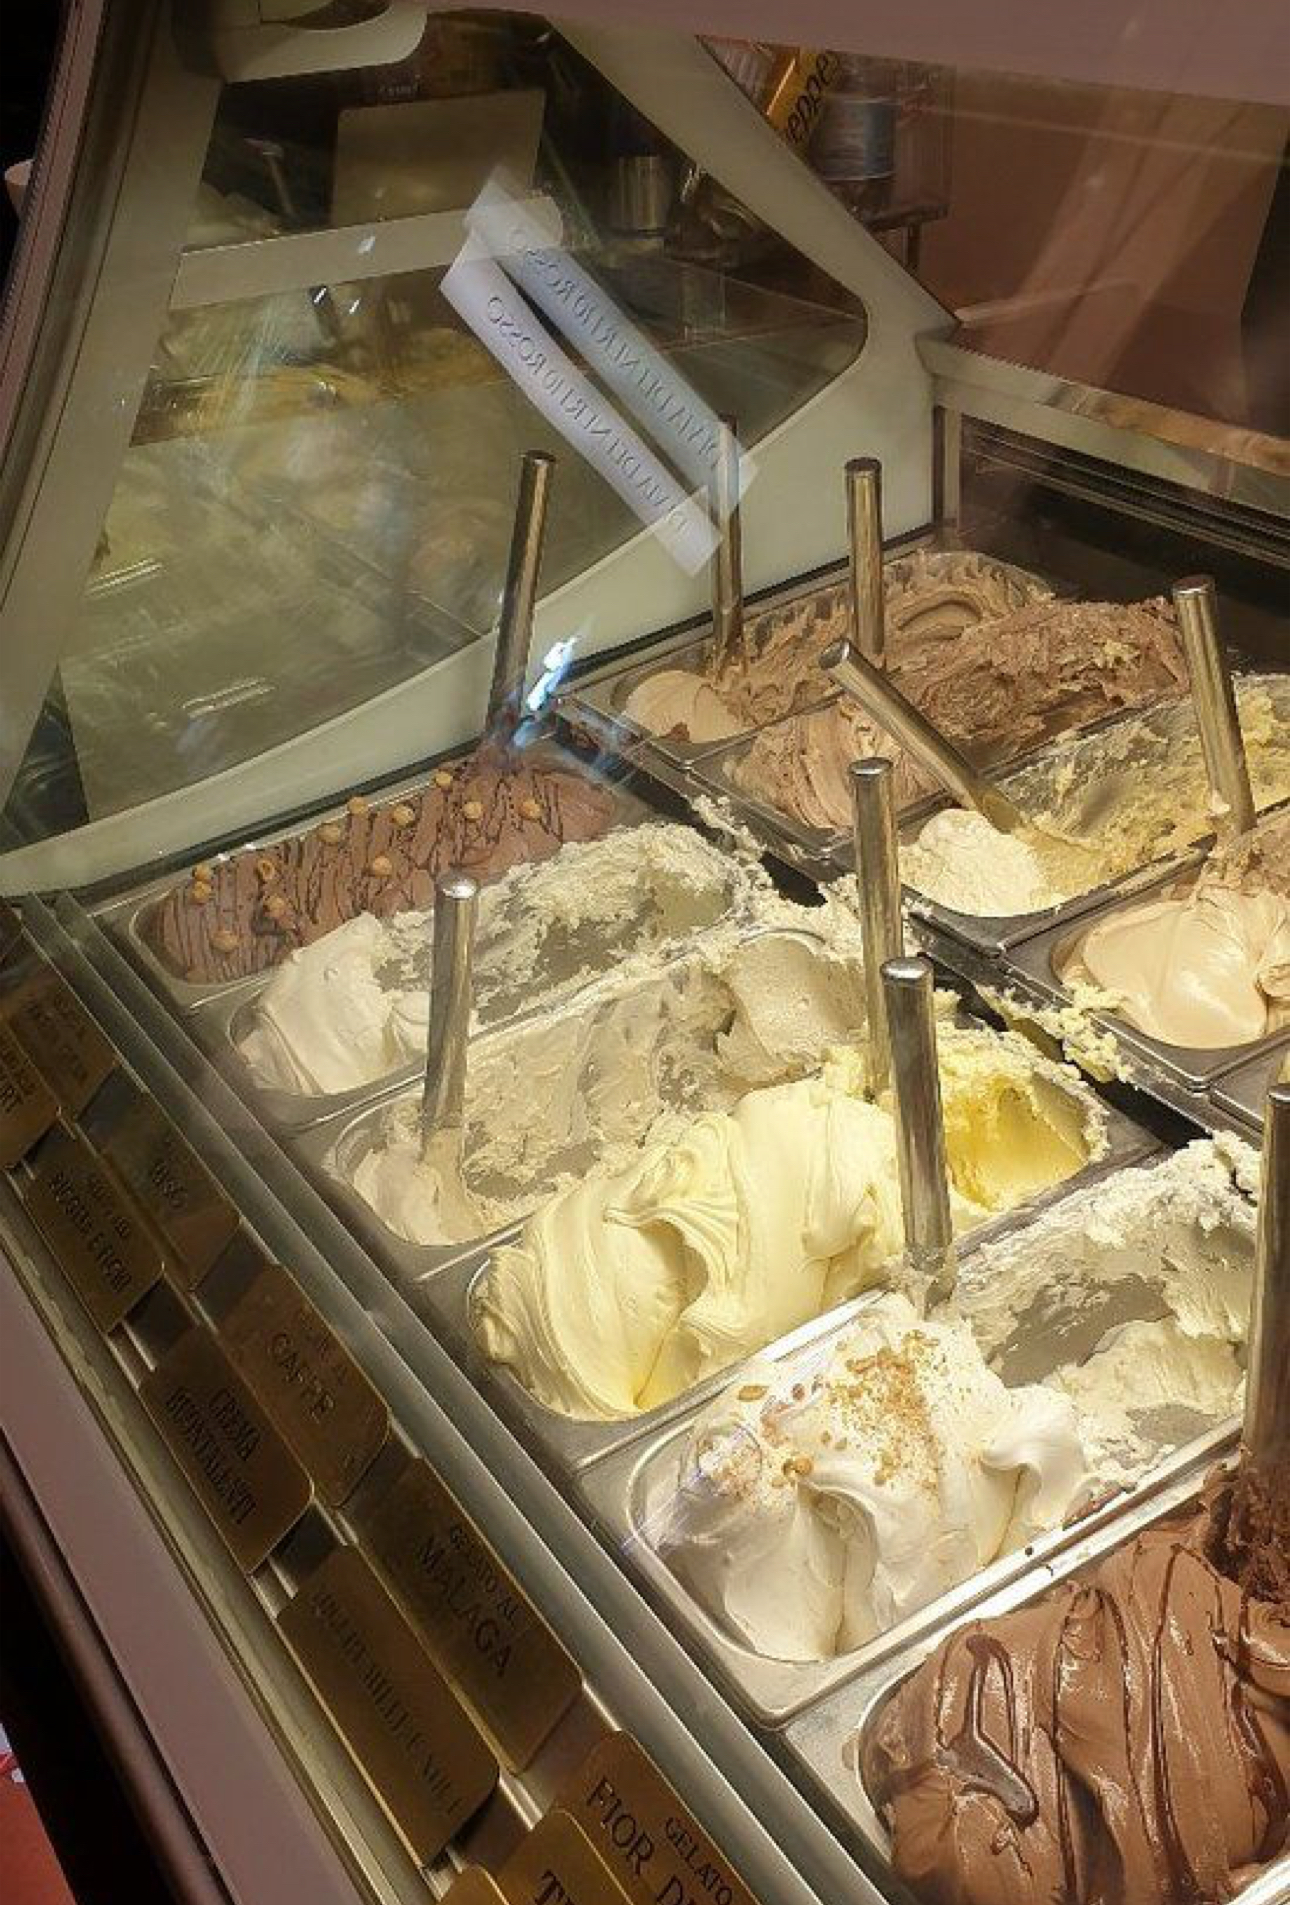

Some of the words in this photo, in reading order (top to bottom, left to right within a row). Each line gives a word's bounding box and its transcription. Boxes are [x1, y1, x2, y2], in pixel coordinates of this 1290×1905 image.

[420, 1534, 512, 1678] MALAGA
[587, 1777, 653, 1875] FIOR
[665, 1817, 732, 1905] GELATO
